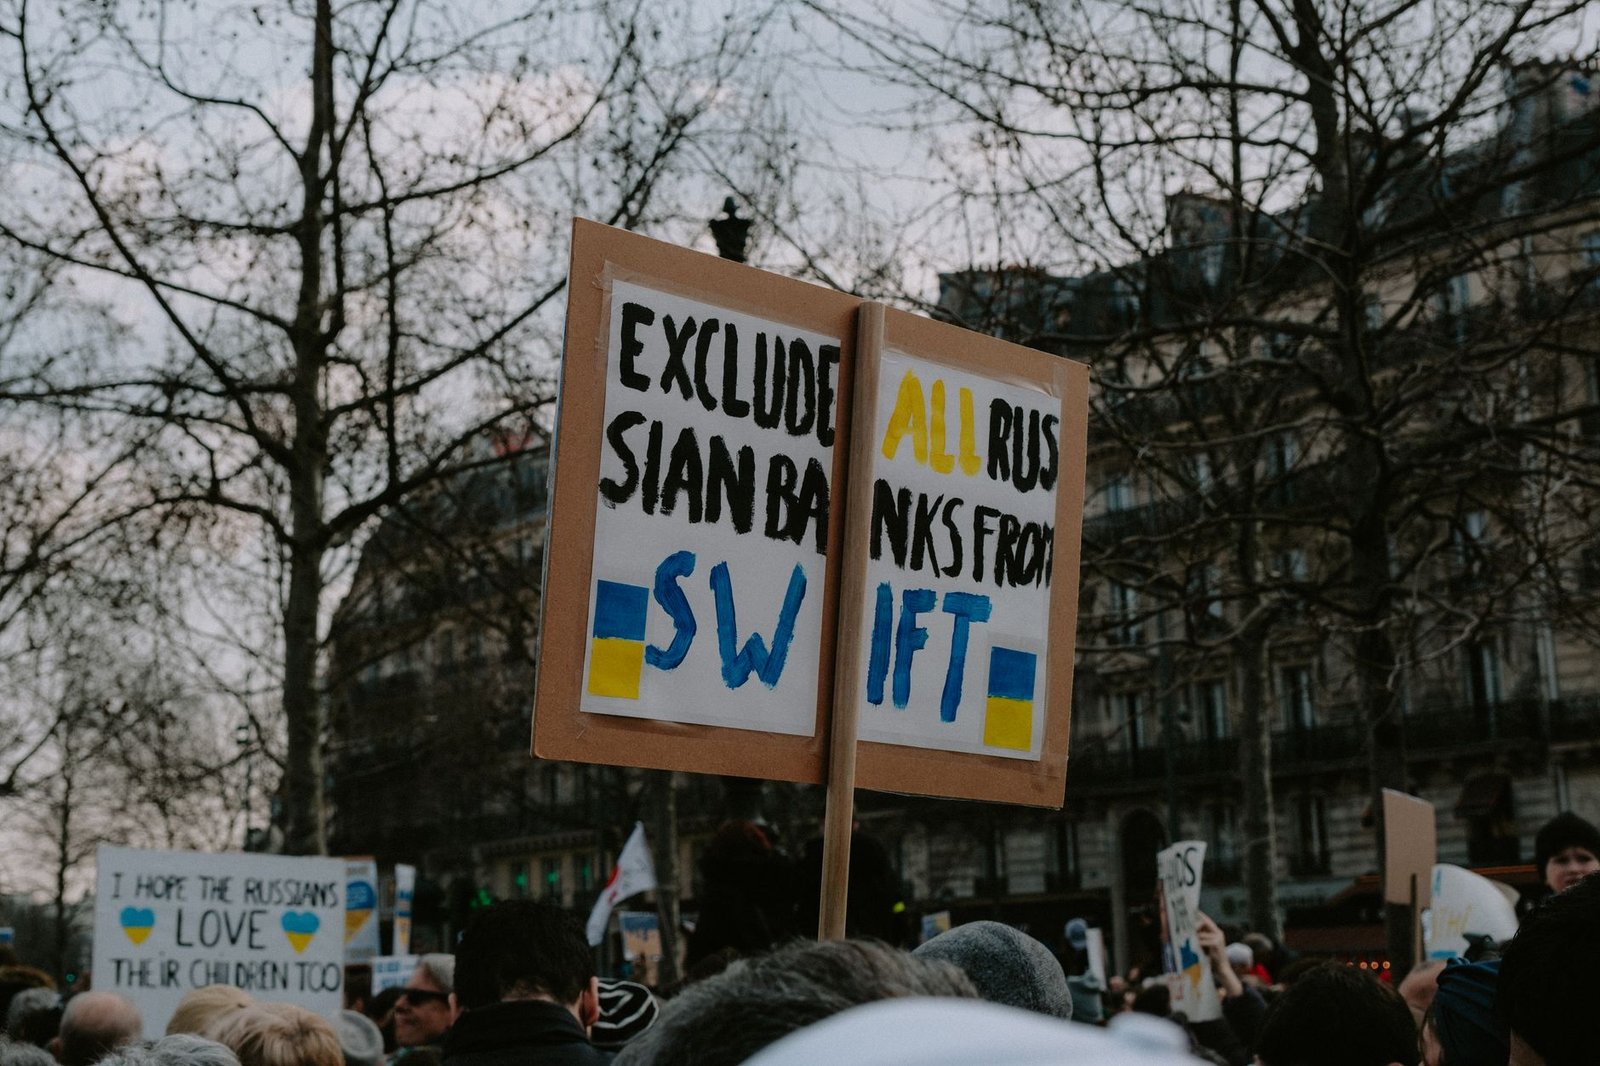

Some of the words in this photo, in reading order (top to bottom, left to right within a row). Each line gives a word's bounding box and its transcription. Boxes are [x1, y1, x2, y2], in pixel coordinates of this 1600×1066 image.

[619, 301, 841, 448] EXCLUDE
[882, 369, 981, 478] ALL
[987, 398, 1059, 494] RUS
[972, 504, 1054, 590] FROM
[112, 872, 123, 898] I
[135, 875, 187, 901] HOPE
[198, 875, 233, 904] THE
[244, 878, 338, 908] RUSSIANS
[176, 908, 267, 950] LOVE
[111, 958, 182, 989] THEIR
[189, 959, 288, 990] CHILDREN
[295, 961, 342, 992] TOO
